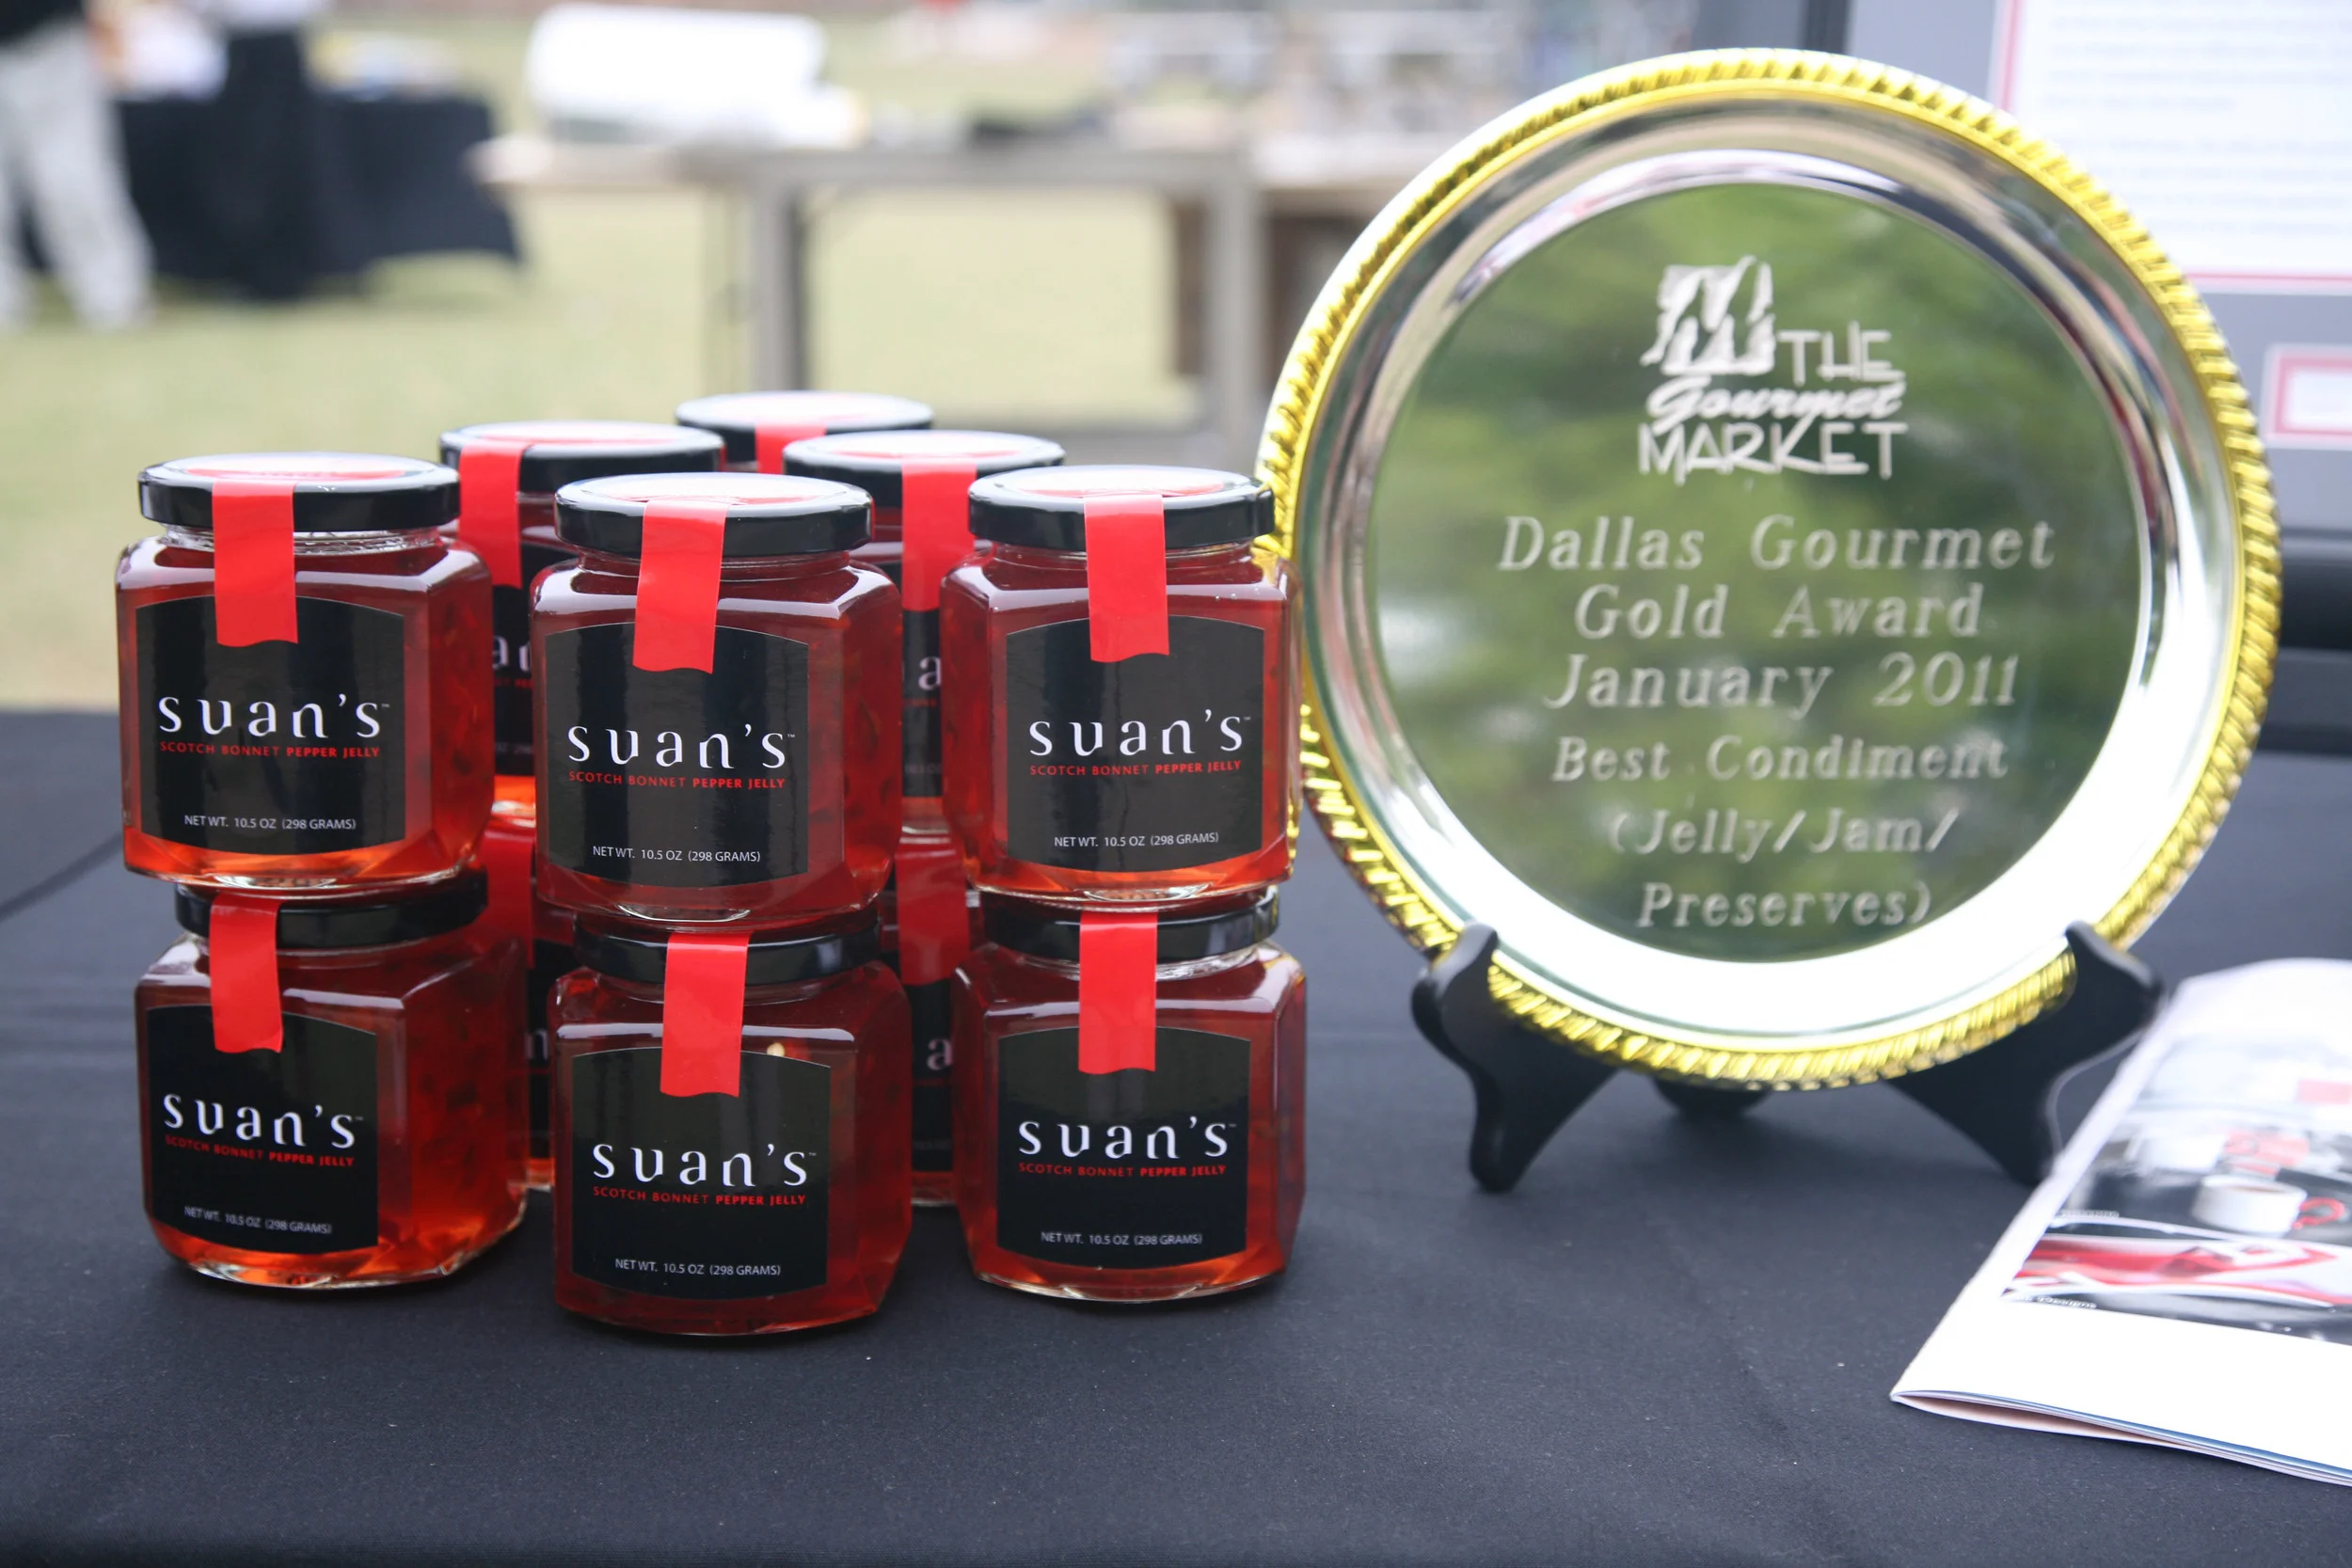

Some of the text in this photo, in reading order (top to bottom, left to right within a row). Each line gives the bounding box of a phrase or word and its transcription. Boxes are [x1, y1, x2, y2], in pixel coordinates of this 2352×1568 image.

[1776, 320, 1906, 387] THE
[1645, 374, 1907, 436] Gourmet
[1637, 415, 1909, 487] MARKET
[1499, 515, 2057, 571] Dallas Gourmet
[1573, 583, 1984, 640] Gold Award
[1543, 652, 2019, 721] January 2011
[158, 693, 381, 739] suan's
[1028, 708, 1243, 756] suan's
[160, 741, 380, 758] SCOTCH BONNET PEPPER JELLY
[567, 723, 787, 769] suan's
[1029, 760, 1242, 776] SCOTCH BONNET PEPPER JELLY
[1551, 735, 2009, 783] Best Condiment
[568, 770, 786, 790] SCOTCH BONNET PEPPER JELLY
[184, 815, 357, 831] NET WT. 10.5 OZ (298 GRAMS)
[1054, 832, 1219, 847] NET WT. 10.5 OZ (298 GRAMS)
[592, 846, 760, 863] NET WT. 10.5 OZ (298 GRAMS)
[1637, 882, 1933, 927] Preserves)
[163, 1093, 356, 1148] suan's
[1018, 1116, 1228, 1159] suan's
[592, 1143, 807, 1187] suan's
[1019, 1162, 1227, 1178] SCOTCH BONNET PEPPER JELLY
[593, 1186, 806, 1206] SCOTCH BONNET PEPPER JELLY
[1041, 1231, 1202, 1246] NET WT. 10.5 OZ (298 GRAMS)
[615, 1259, 781, 1276] NET WT. 10.5 OZ (298 GRAMS)
